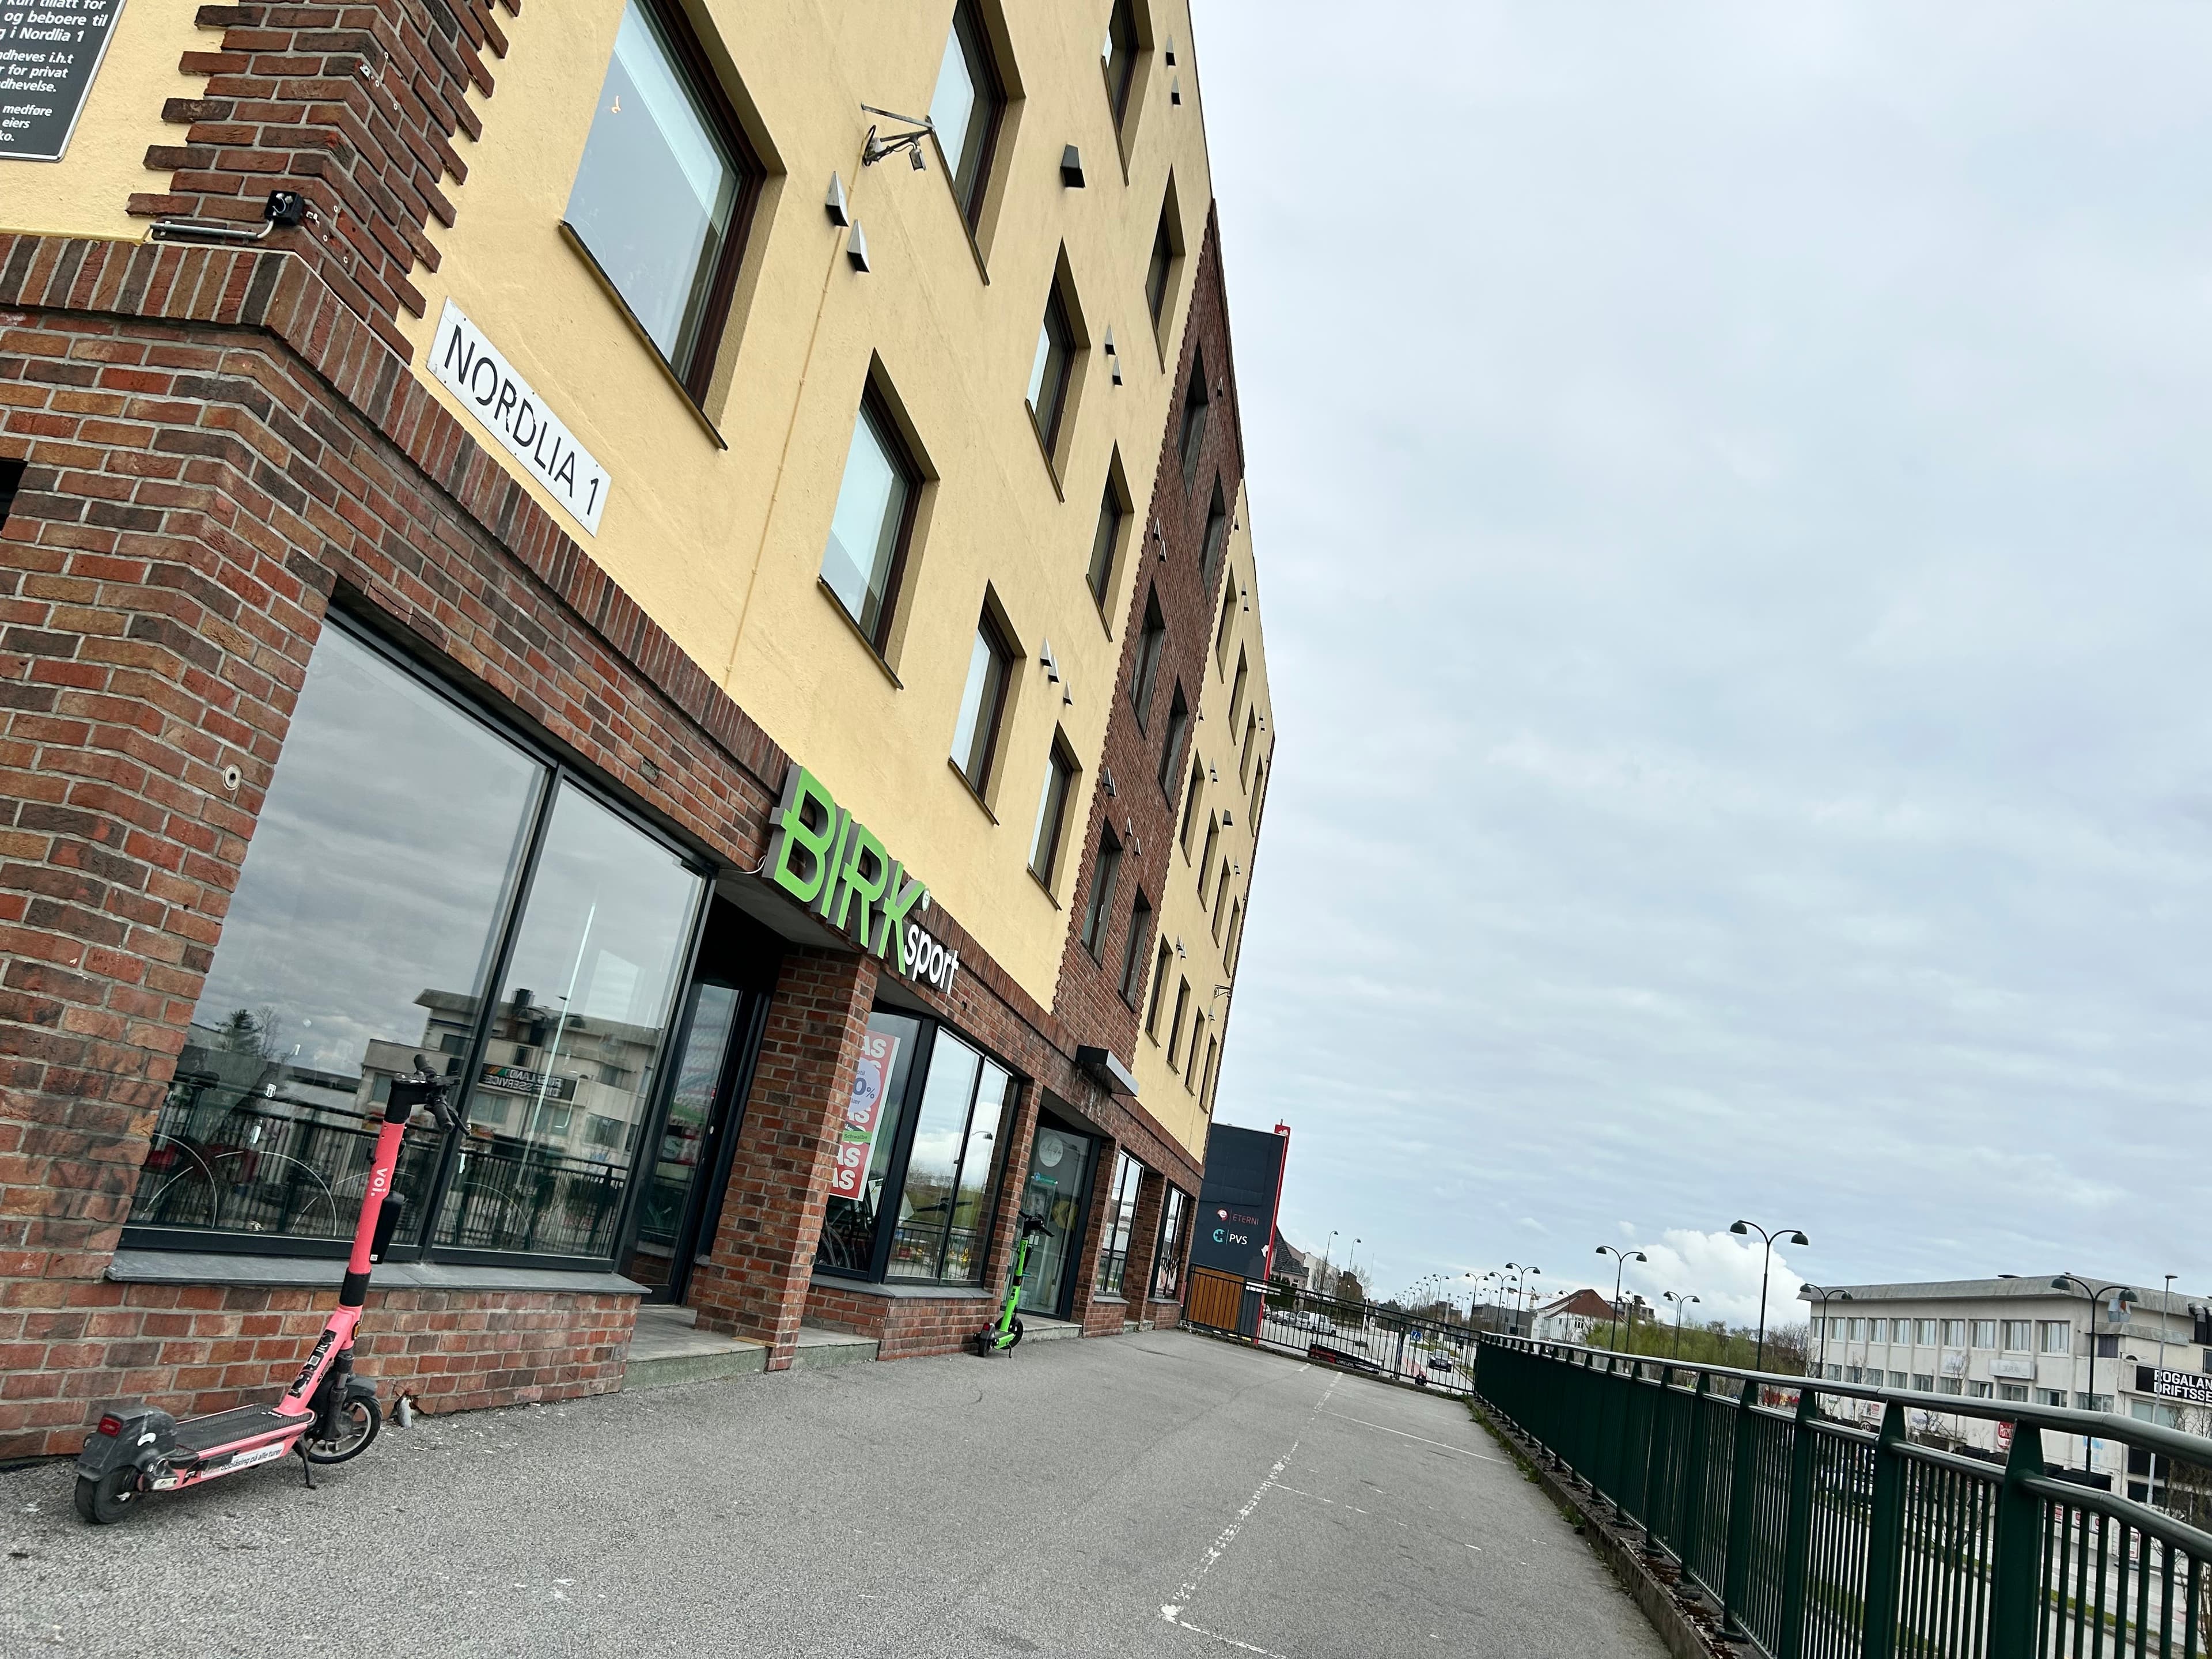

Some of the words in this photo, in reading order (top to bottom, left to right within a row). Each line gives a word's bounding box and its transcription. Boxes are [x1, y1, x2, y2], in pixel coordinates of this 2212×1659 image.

[84, 0, 107, 10] for
[4, 12, 24, 25] og
[27, 10, 87, 26] beboere
[92, 14, 108, 27] til
[10, 26, 17, 38] i
[19, 28, 71, 42] Nordlia
[77, 31, 85, 42] 1
[48, 52, 74, 64] i.h.t
[8, 64, 28, 75] for
[29, 66, 69, 78] privat
[0, 78, 56, 92] dhevelse.
[2, 117, 31, 128] eiers
[444, 324, 575, 498] NORDLIA
[587, 478, 599, 516] 1
[774, 766, 926, 975] BIRK
[903, 924, 960, 994] sport
[370, 1168, 388, 1197] voi.
[1229, 1233, 1248, 1245] PVS
